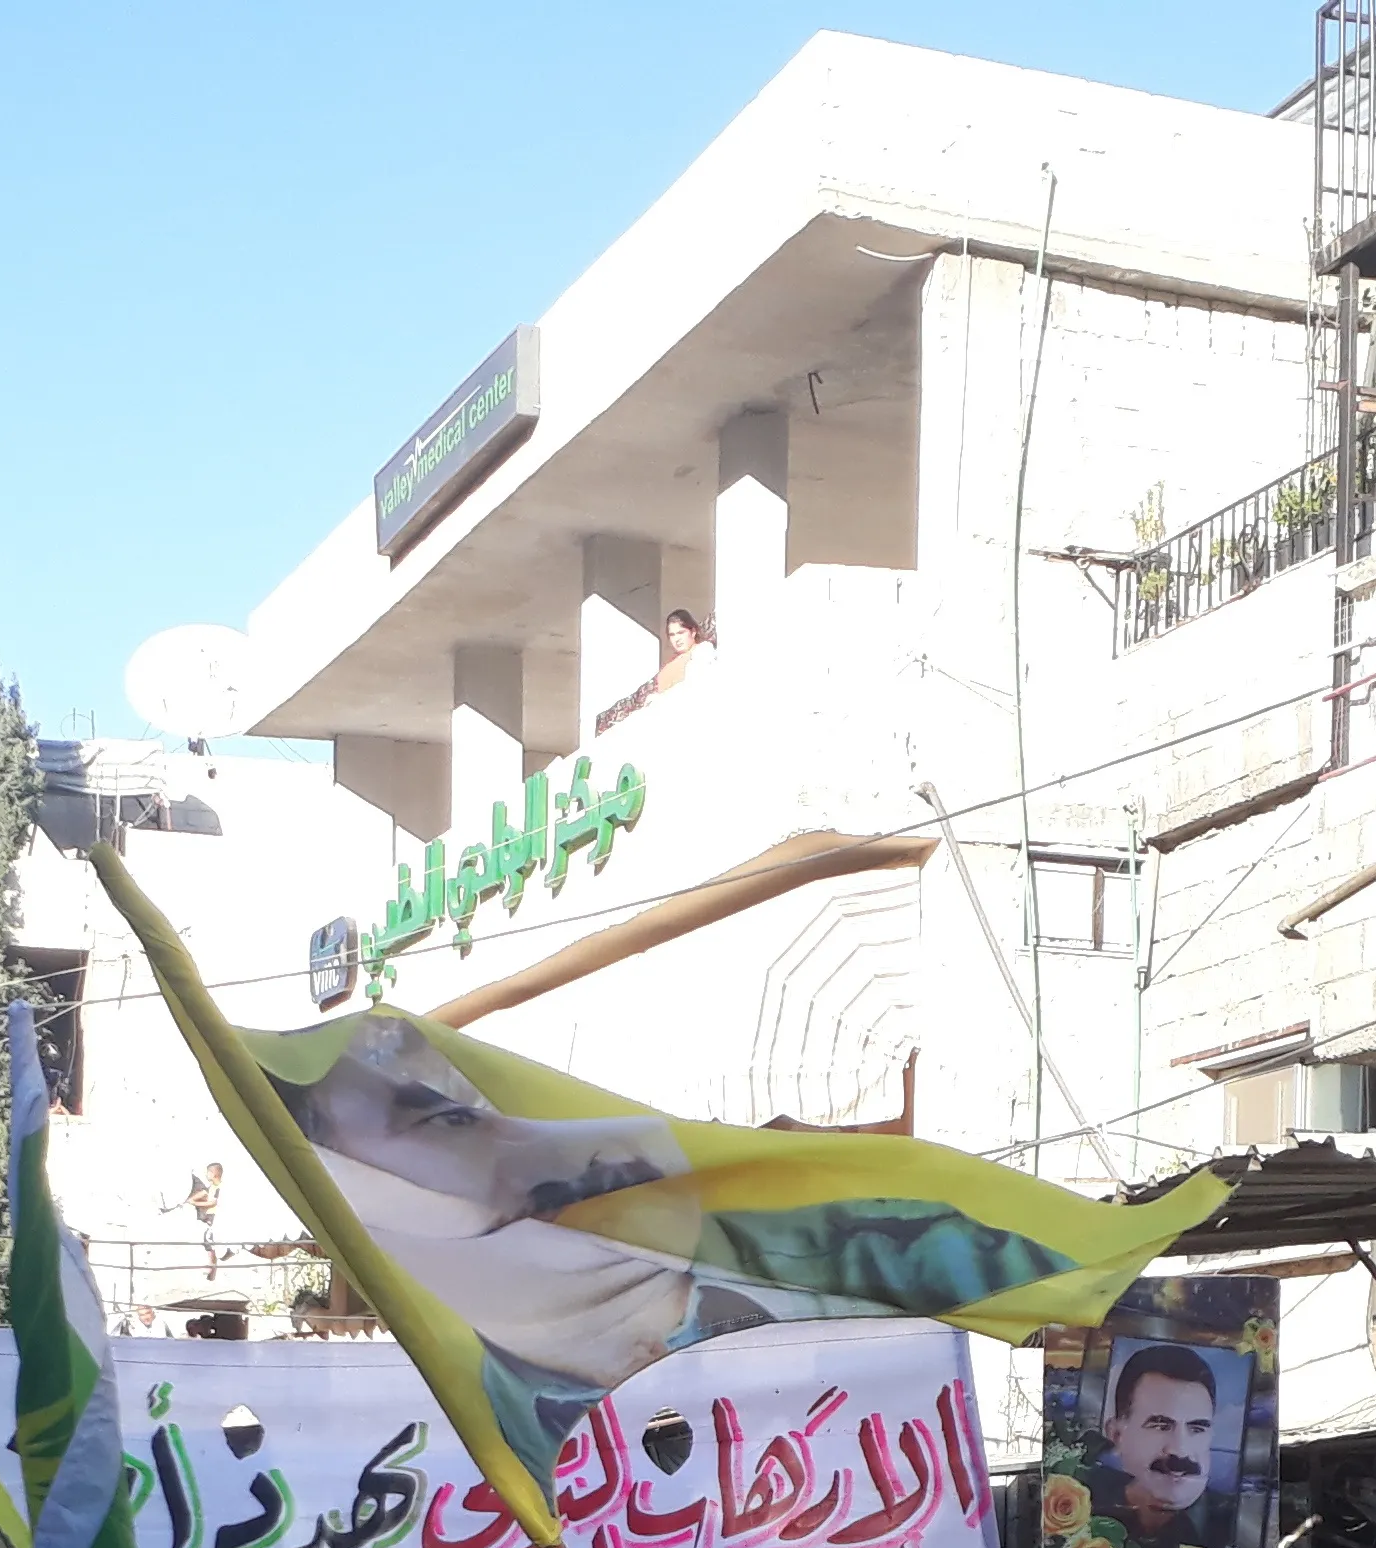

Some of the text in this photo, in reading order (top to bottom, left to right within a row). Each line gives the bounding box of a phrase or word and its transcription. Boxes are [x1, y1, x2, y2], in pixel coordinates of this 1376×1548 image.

[380, 365, 516, 519] valley medical center
[545, 755, 646, 899] مركز
[360, 838, 446, 1003] الطبي
